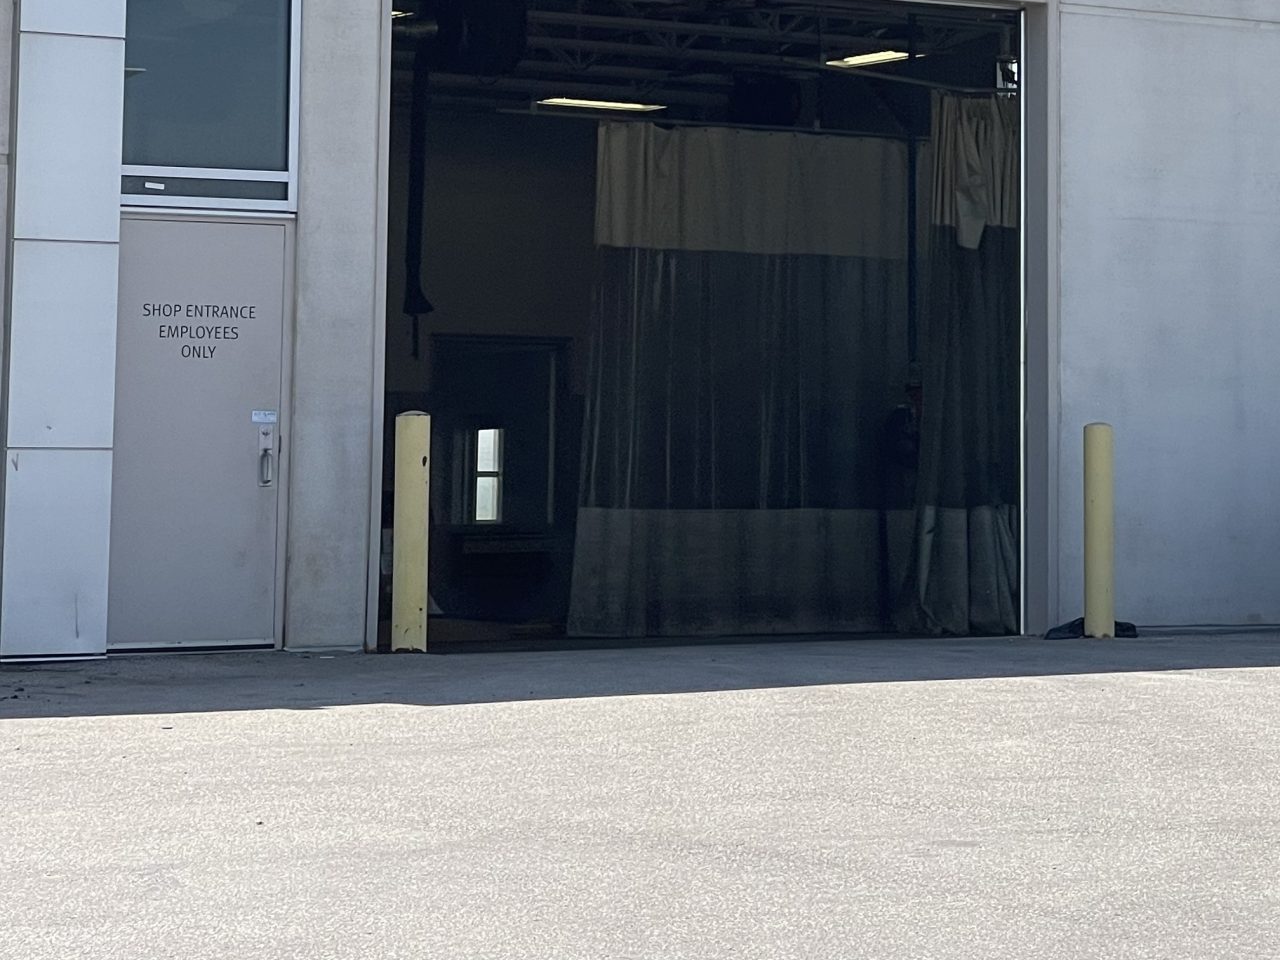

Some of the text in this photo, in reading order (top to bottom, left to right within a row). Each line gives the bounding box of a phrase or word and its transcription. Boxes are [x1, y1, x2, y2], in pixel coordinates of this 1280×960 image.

[142, 303, 256, 319] SHOP ENTRANCE
[159, 325, 239, 339] EMPLOYEES
[181, 344, 216, 358] ONLY
